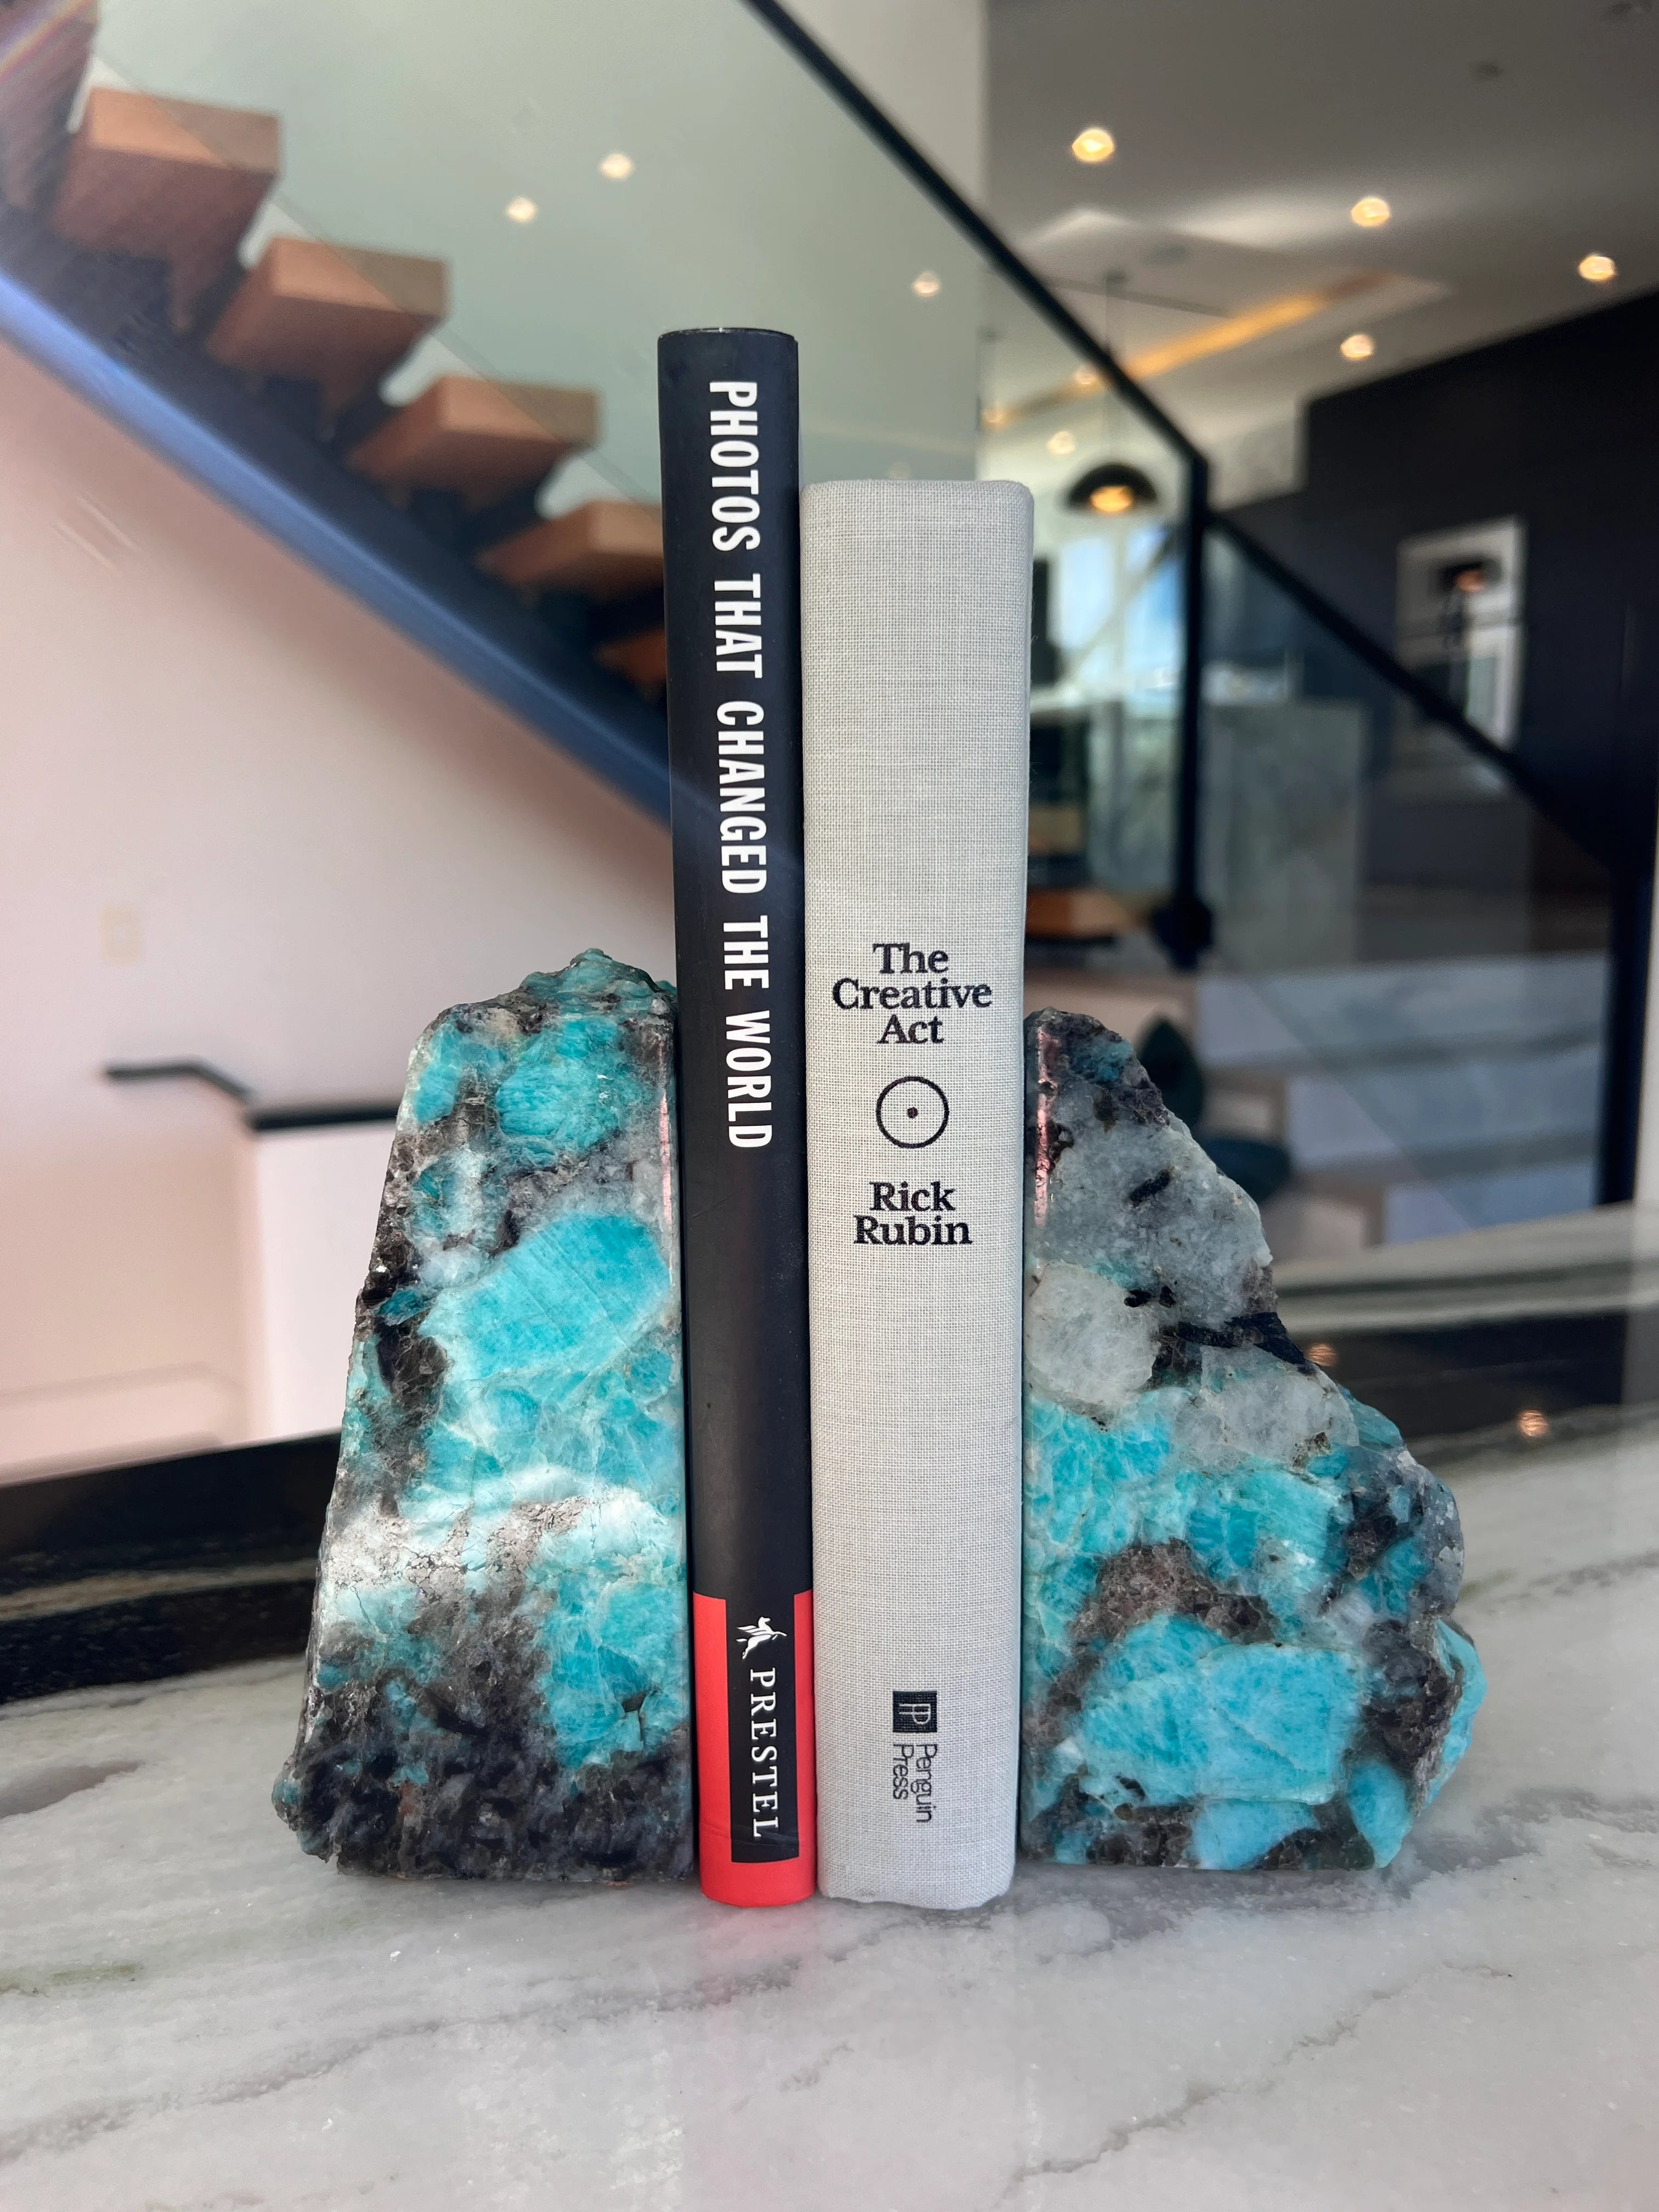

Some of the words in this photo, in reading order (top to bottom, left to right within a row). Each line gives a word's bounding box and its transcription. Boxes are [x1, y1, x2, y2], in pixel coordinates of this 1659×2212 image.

[709, 381, 761, 551] PHOTOS
[714, 573, 763, 679] THAT
[716, 701, 767, 894] CHANGED
[723, 915, 769, 990] THE
[872, 942, 950, 974] The
[832, 978, 992, 1011] Creative
[876, 1013, 945, 1045] Act
[725, 1010, 772, 1148] WORLD
[853, 1214, 973, 1246] Rubin
[868, 1181, 956, 1212] Rick
[750, 1667, 778, 1837] PRESTEL
[893, 1743, 915, 1800] Press
[910, 1743, 938, 1823] Penguin
